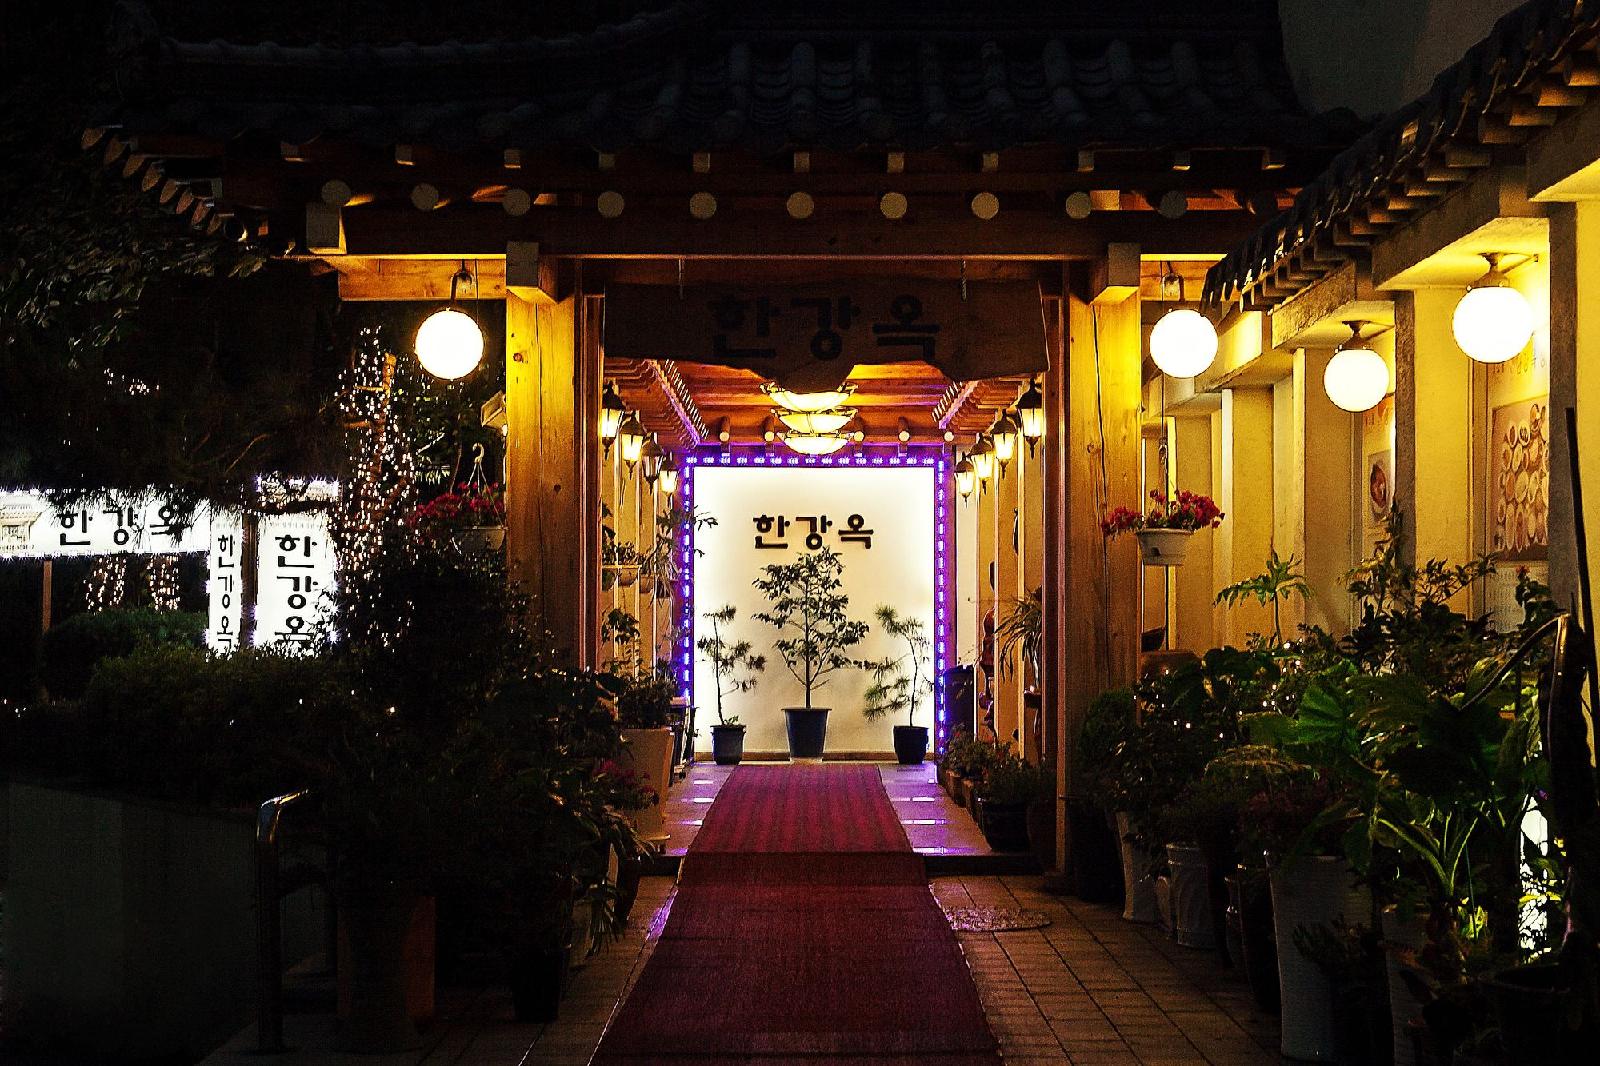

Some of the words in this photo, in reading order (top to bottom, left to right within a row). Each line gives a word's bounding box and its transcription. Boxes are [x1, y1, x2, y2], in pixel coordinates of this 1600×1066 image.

[707, 294, 940, 361] 한강옥
[753, 515, 874, 550] 한강옥
[217, 534, 236, 649] 한강옥
